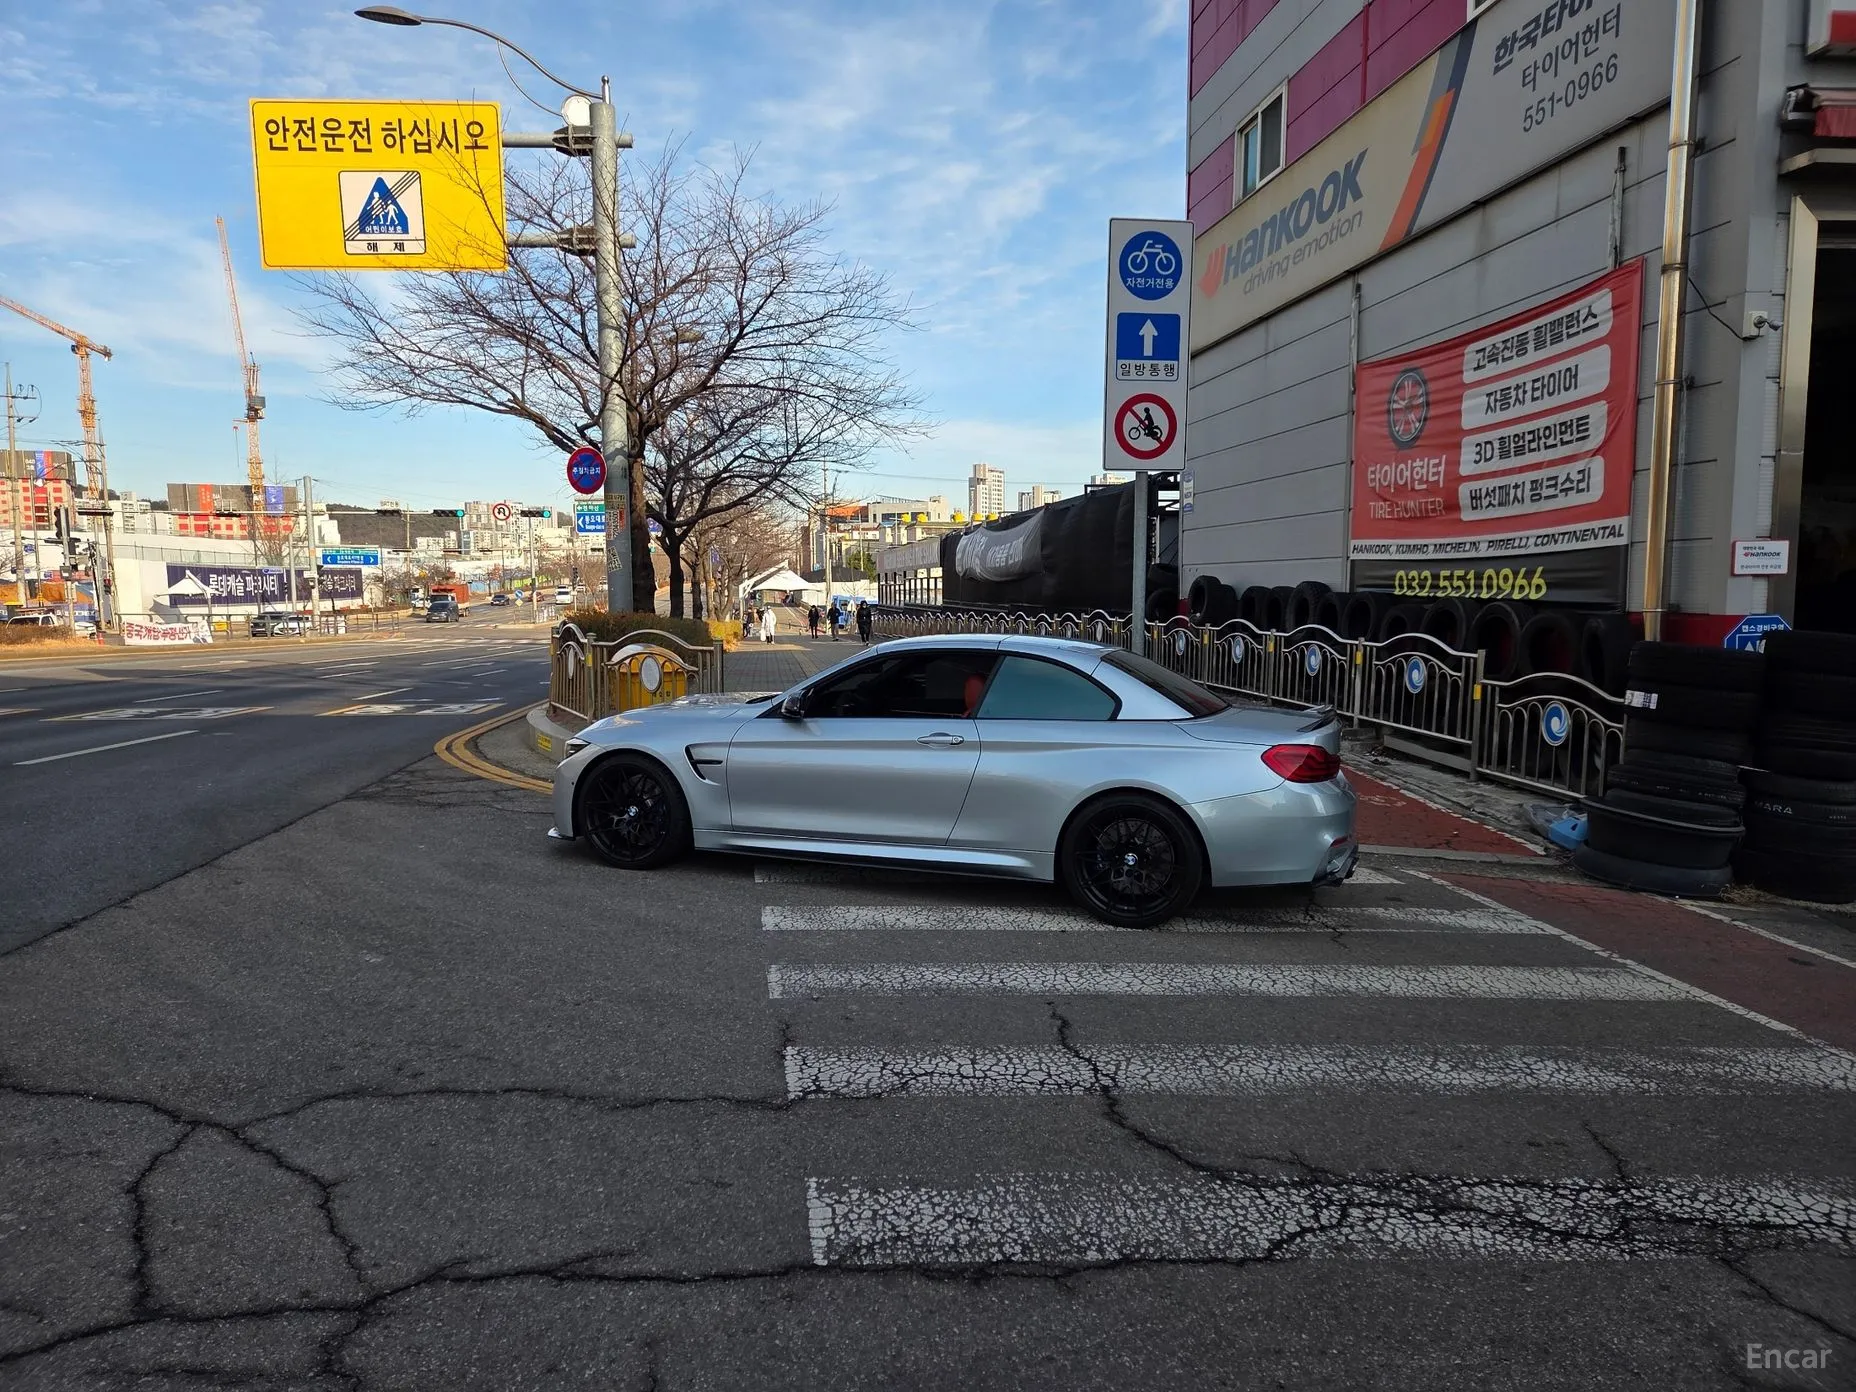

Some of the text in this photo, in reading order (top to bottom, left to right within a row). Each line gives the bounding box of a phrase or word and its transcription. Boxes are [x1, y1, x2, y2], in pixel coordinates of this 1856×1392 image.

[1522, 3, 1621, 92] 타이어헌터
[1523, 53, 1618, 133] 551-0966
[265, 115, 489, 154] 안전운전 하십시오
[365, 225, 403, 233] 어린이보호
[1243, 210, 1363, 295] driving emotion
[1126, 277, 1174, 289] 자전거전용
[1473, 305, 1600, 372] 고속진동 휠밸런스
[1120, 363, 1175, 377] 일방통행
[1485, 363, 1579, 415] 자동차 타이어
[1473, 414, 1591, 464] 3D 휠얼라인먼트
[1367, 454, 1447, 493] 타이어헌터
[1469, 467, 1591, 511] 버섯패치 펑크수리
[1369, 497, 1446, 519] TIRE HUNTER
[1352, 543, 1393, 556] HANKOOK,
[1432, 541, 1482, 554] MICHELIN,
[1487, 537, 1530, 551] PIRELLI,
[1533, 524, 1624, 547] CONTINENTAL
[1393, 566, 1547, 600] 032.551.0966
